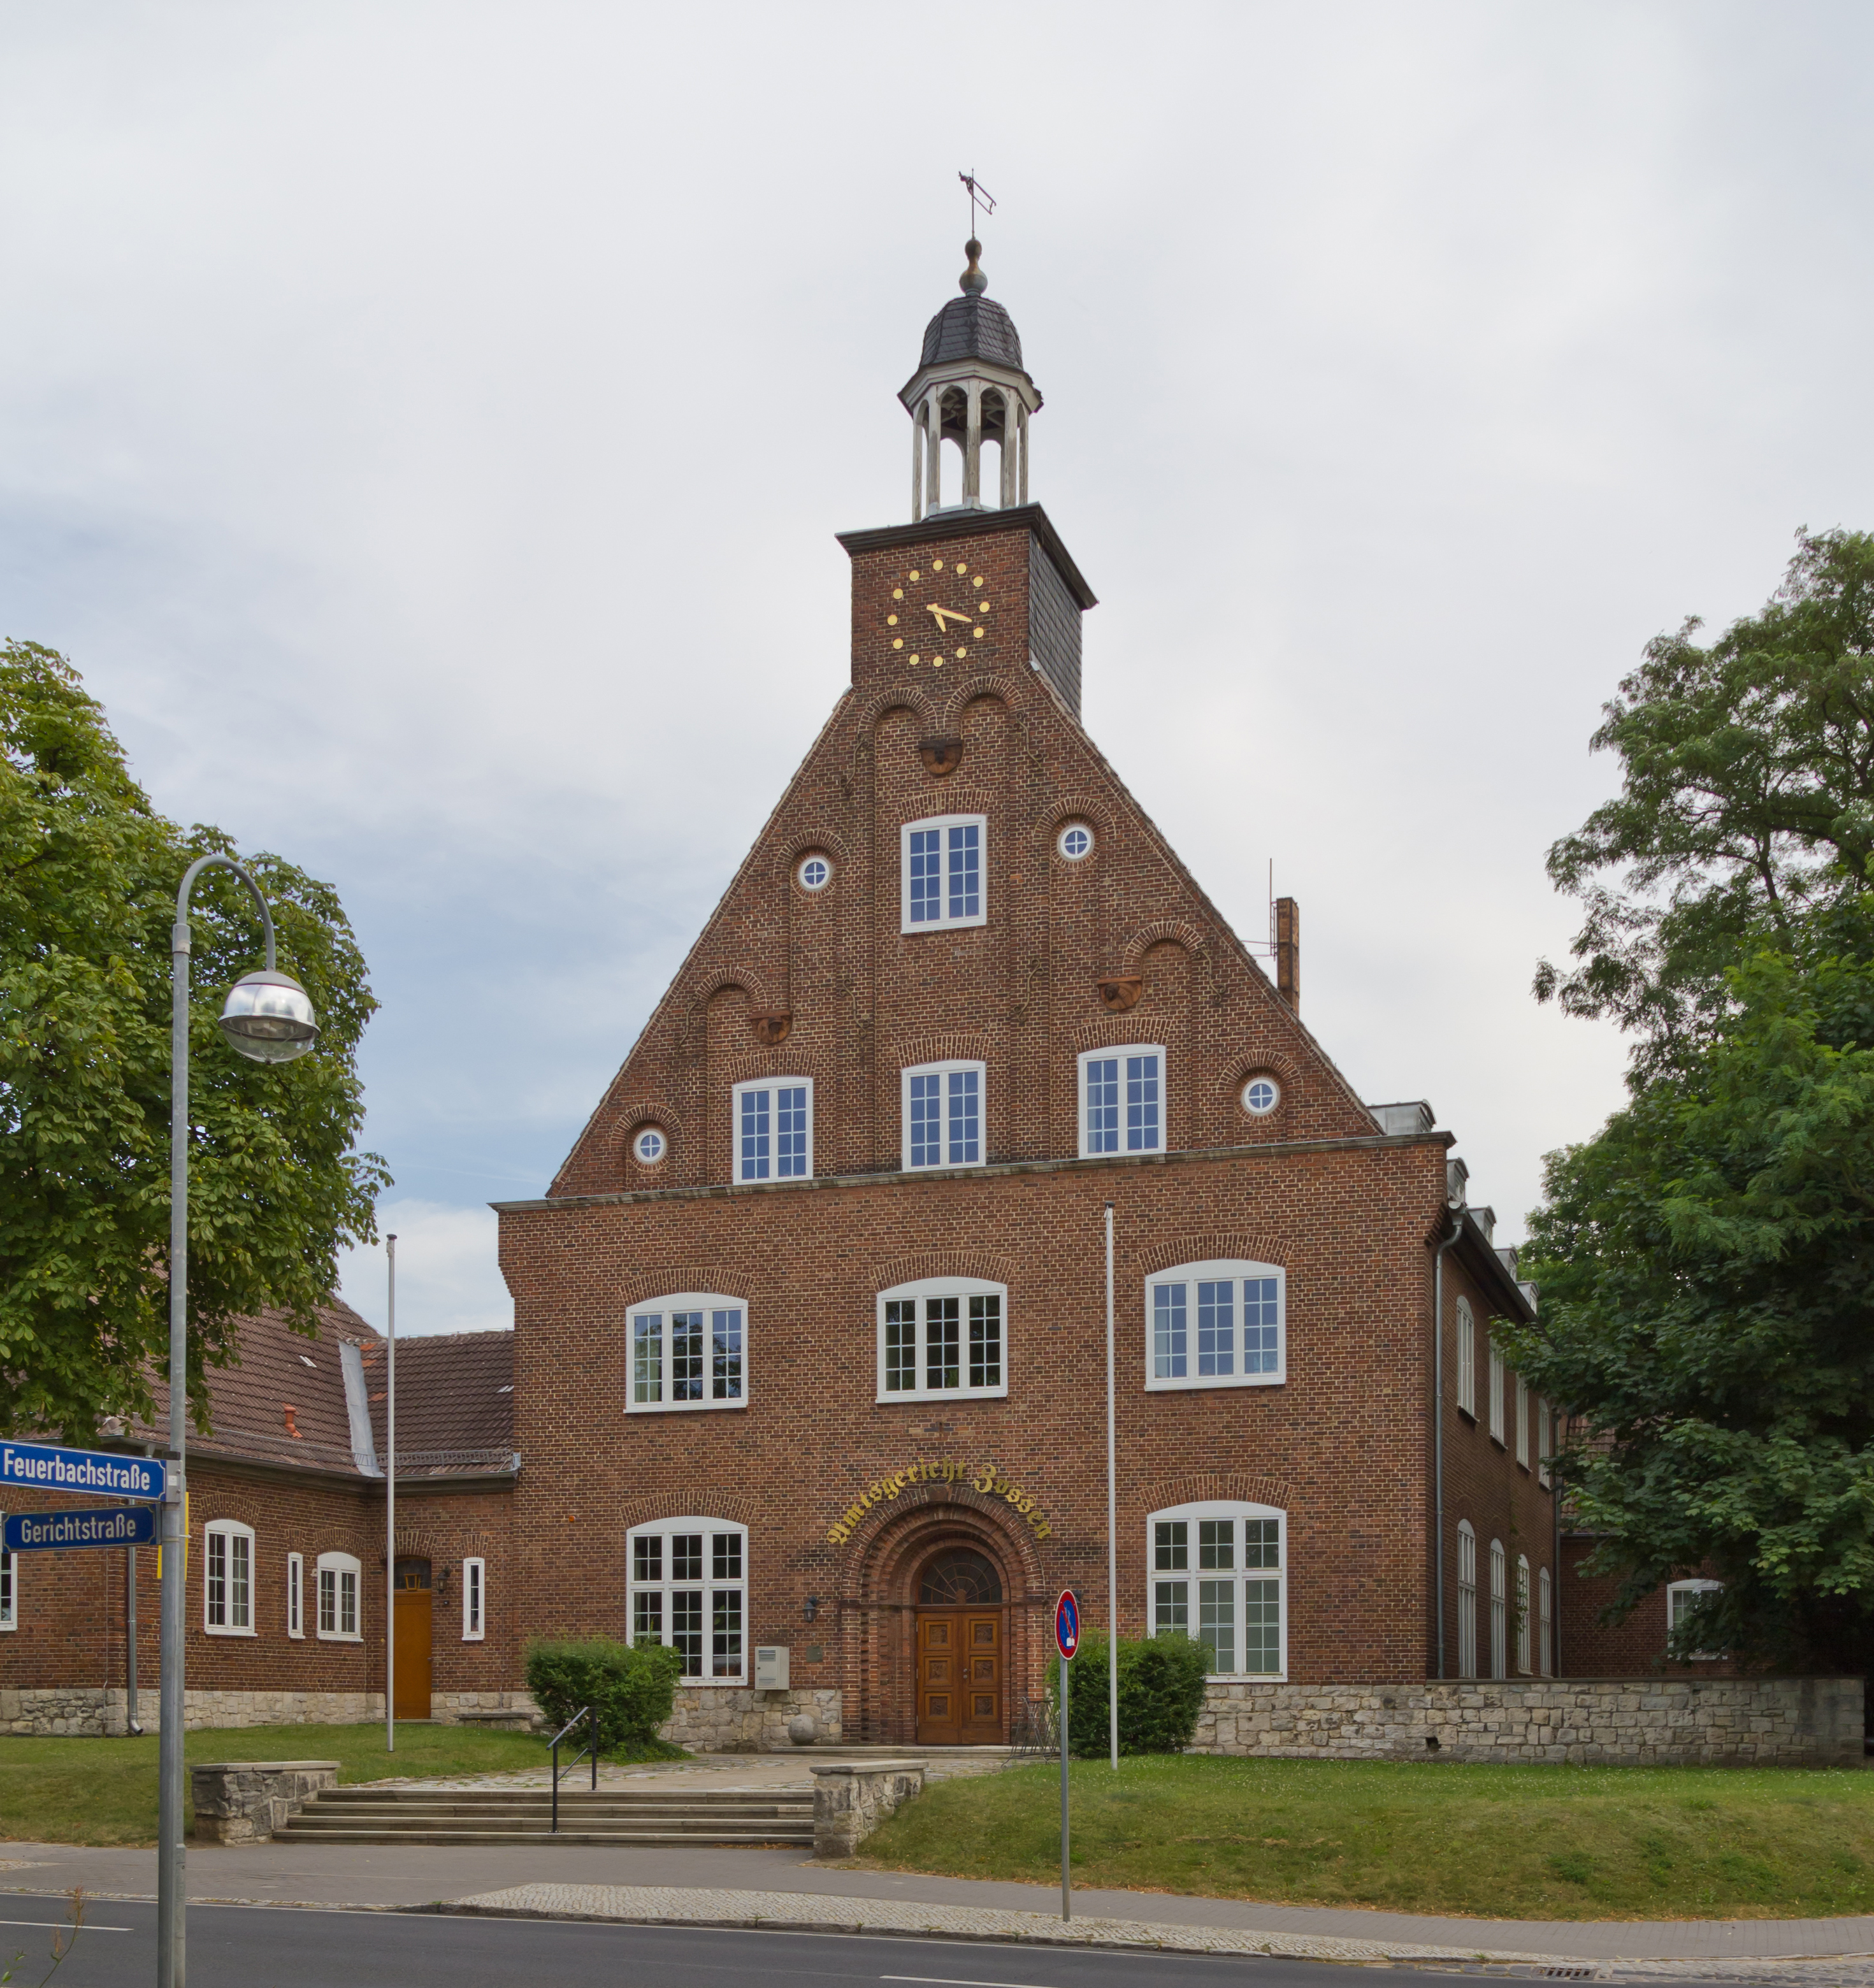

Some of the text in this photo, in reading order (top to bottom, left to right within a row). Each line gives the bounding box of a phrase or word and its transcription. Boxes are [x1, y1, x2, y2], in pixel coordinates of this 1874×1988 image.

[3, 1448, 150, 1490] Feuerbachstraße
[827, 1456, 1053, 1547] Amtsgericht Zossen
[21, 1513, 136, 1543] Gerichtstraße
